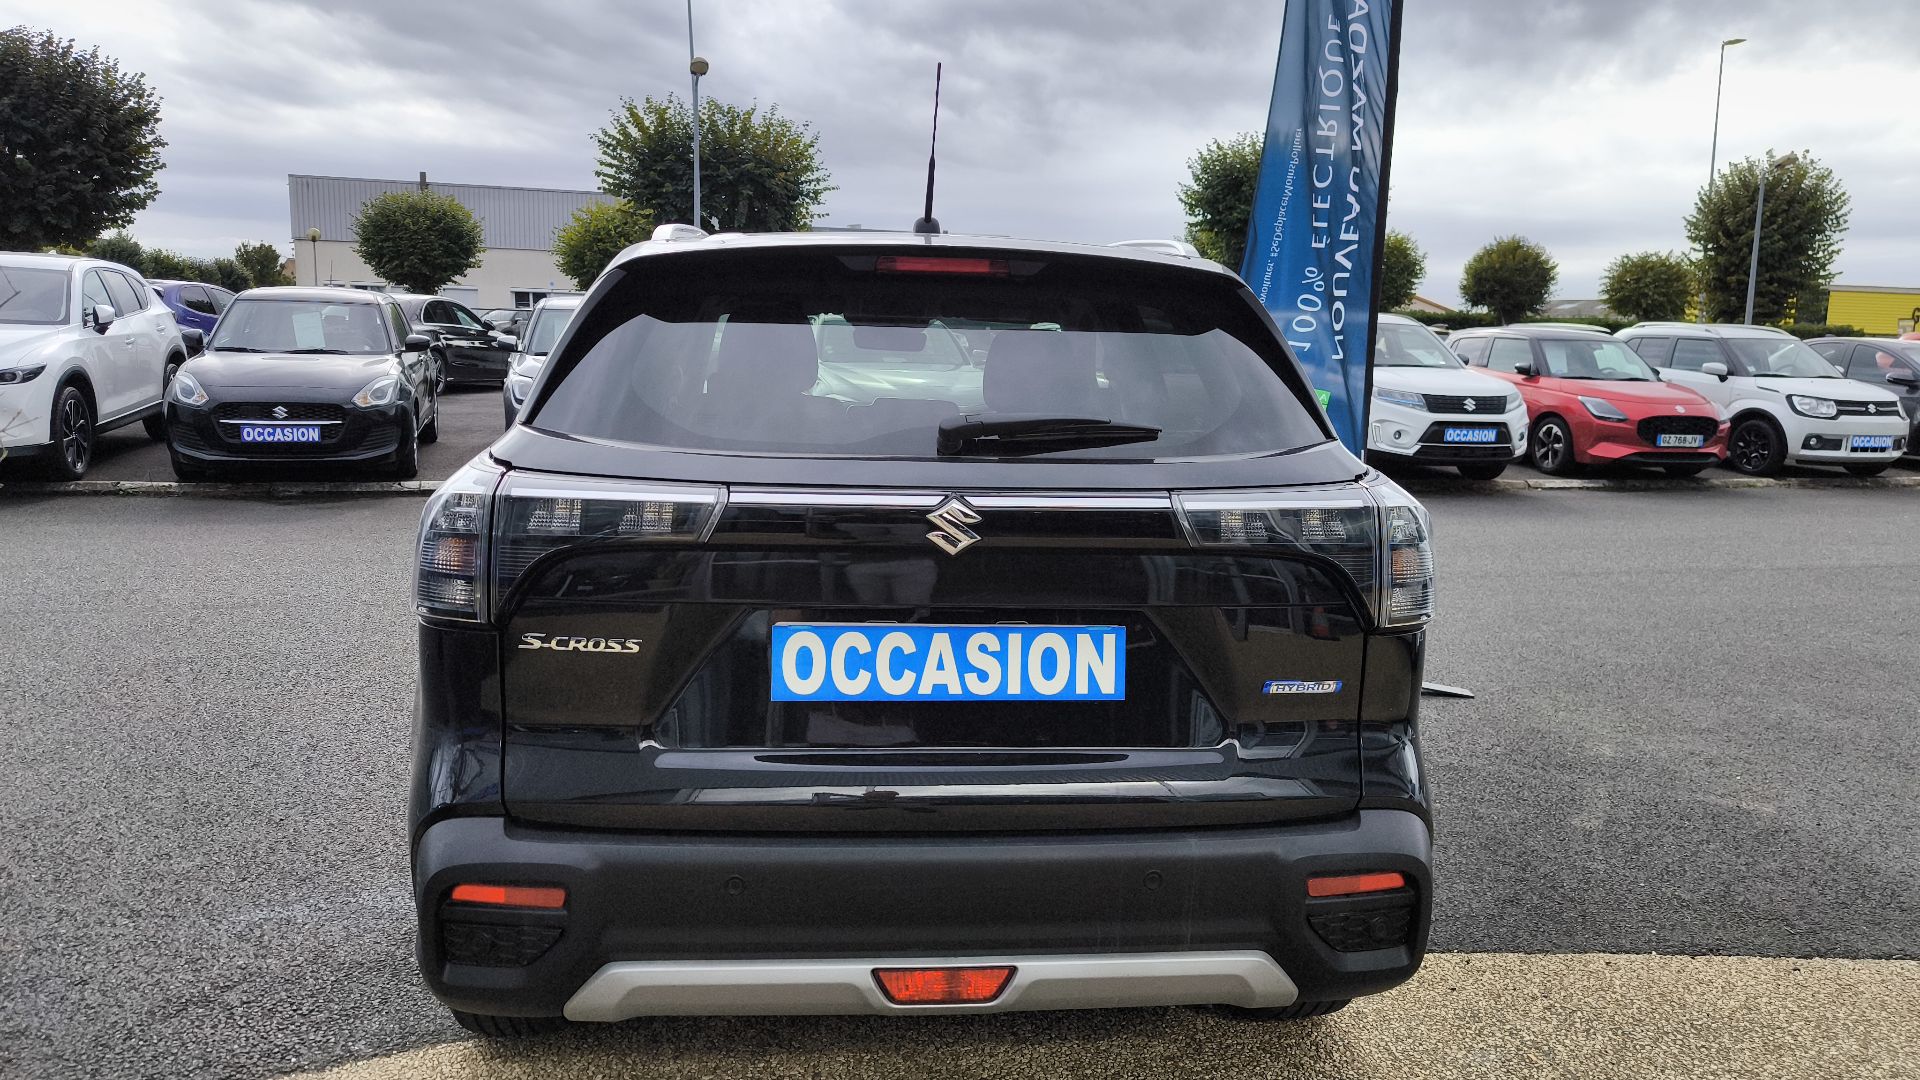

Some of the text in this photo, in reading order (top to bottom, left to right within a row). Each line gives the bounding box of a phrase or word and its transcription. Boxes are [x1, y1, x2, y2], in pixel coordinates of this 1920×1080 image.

[242, 427, 319, 442] OCCASION
[1446, 430, 1497, 442] OCCASION
[1852, 435, 1893, 448] OCCASION
[518, 632, 642, 653] S-CROSS
[782, 631, 1116, 696] OCCASION
[1276, 682, 1332, 692] HYBRID
